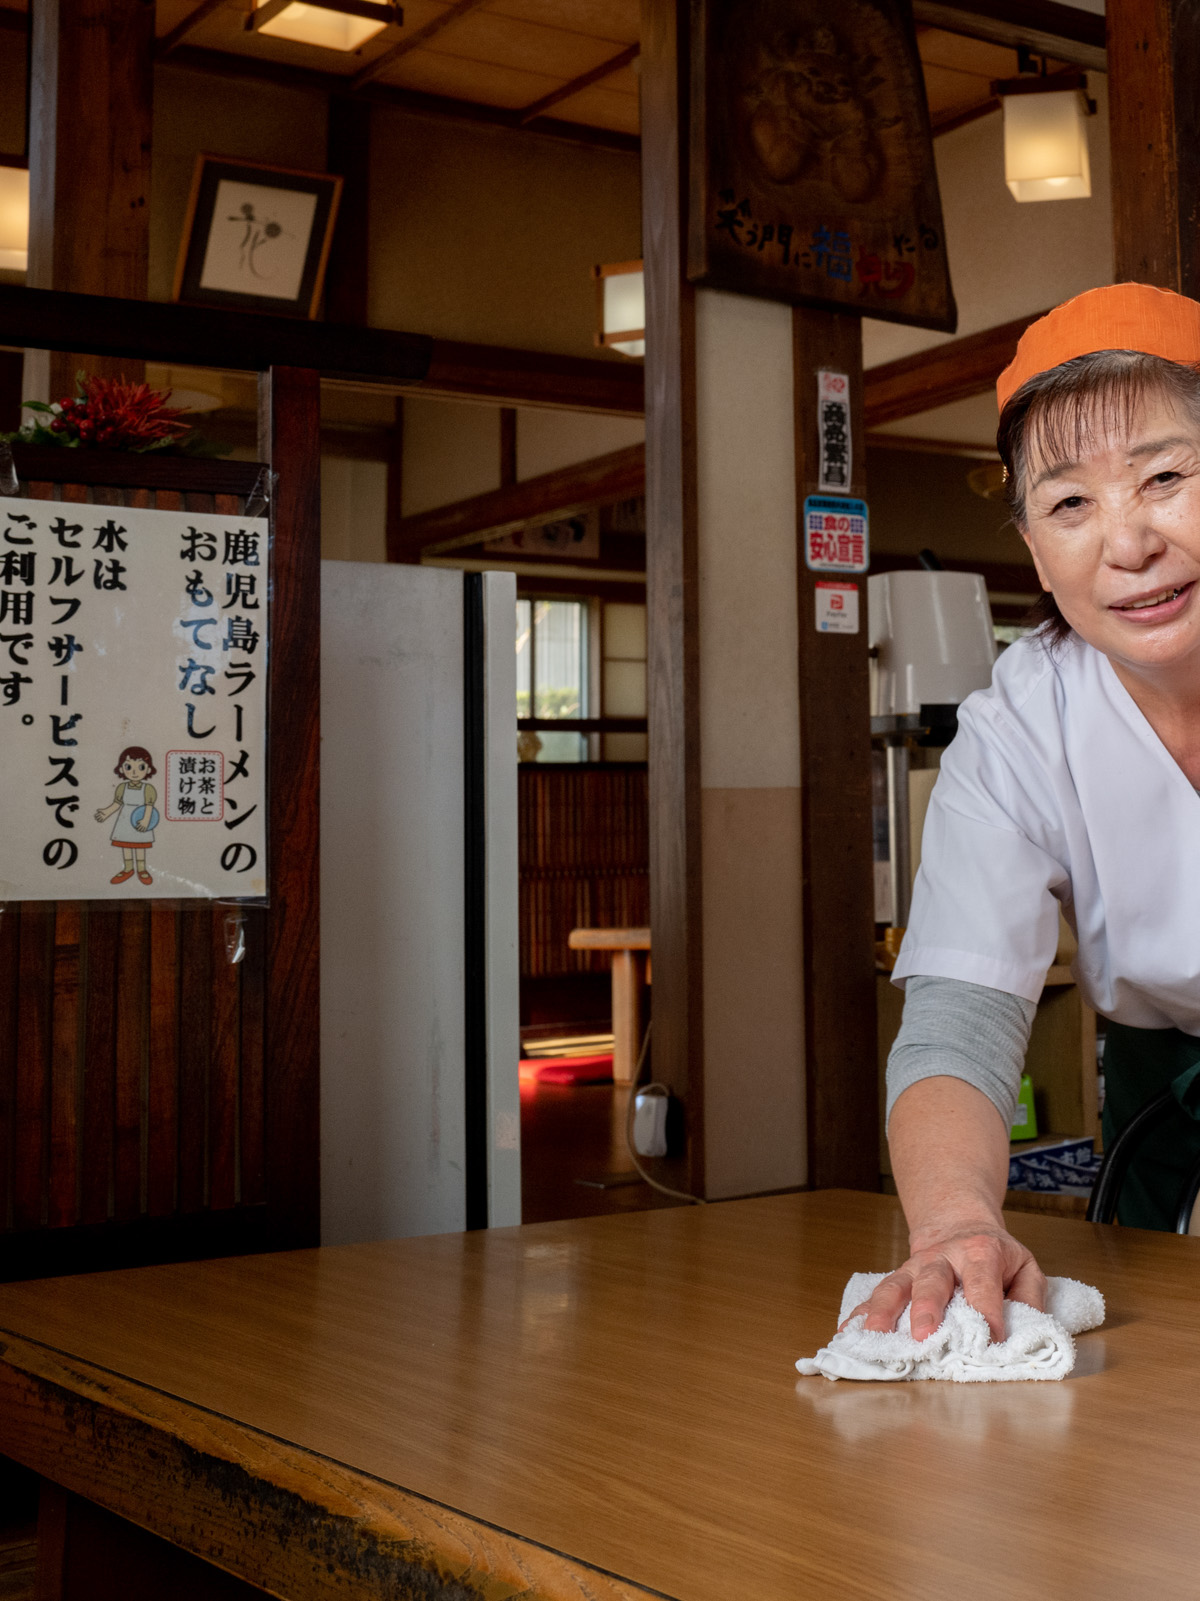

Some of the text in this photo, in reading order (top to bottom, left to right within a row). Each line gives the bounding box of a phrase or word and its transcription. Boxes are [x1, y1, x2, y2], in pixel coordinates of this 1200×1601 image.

[92, 519, 129, 592] 水は
[810, 532, 864, 564] 安心宣言
[824, 516, 850, 532] 食の
[0, 512, 38, 727] ご利用です。
[179, 525, 218, 740] おもてなし
[42, 517, 84, 870] セルフサービスでの
[220, 529, 262, 874] 鹿児島ラーメンの
[177, 757, 197, 816] 漬け物
[197, 757, 217, 816] お茶と
